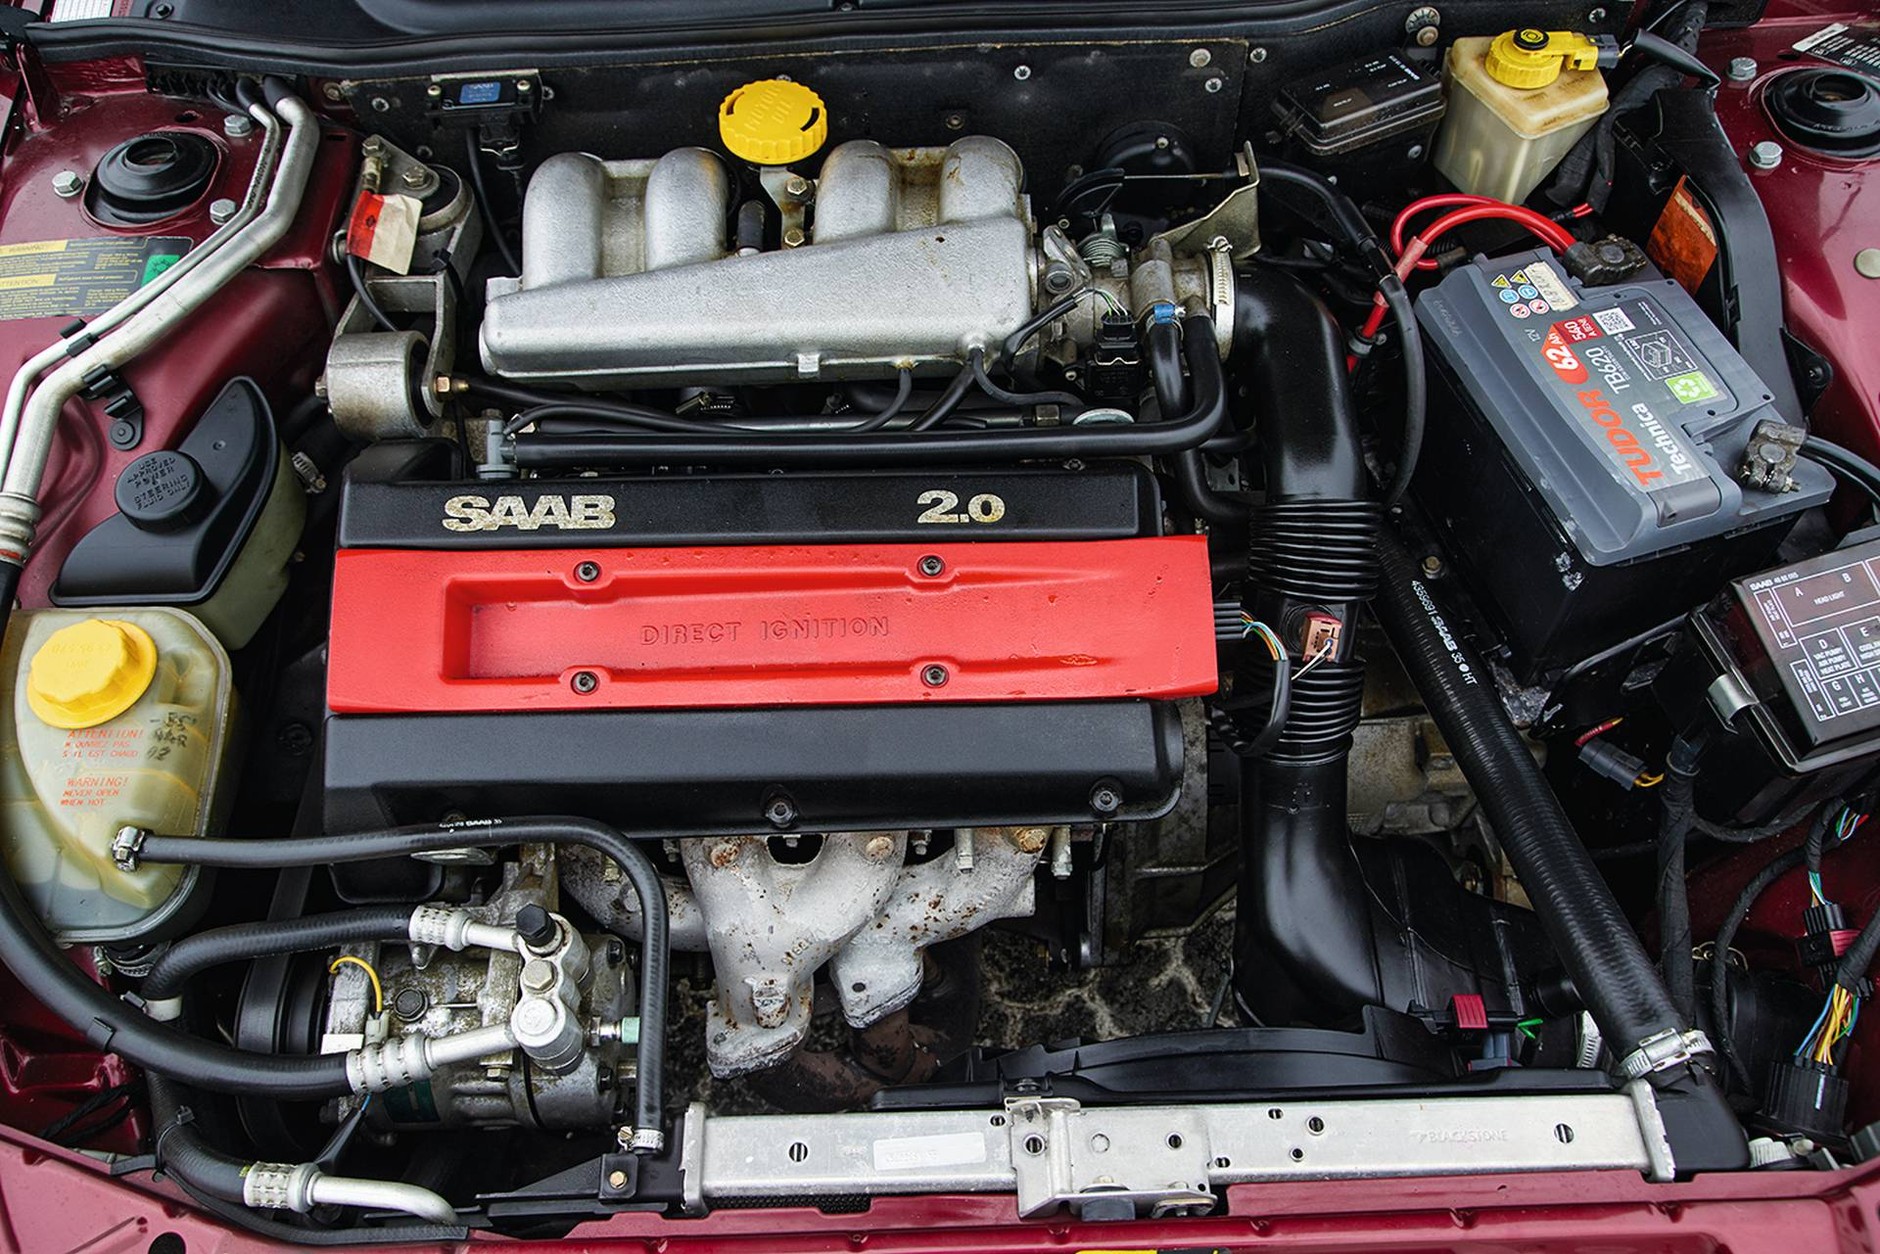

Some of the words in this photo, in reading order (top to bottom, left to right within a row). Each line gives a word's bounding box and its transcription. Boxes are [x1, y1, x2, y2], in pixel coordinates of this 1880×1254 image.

[1564, 321, 1587, 341] 540
[1549, 333, 1563, 346] Ah
[1546, 347, 1579, 371] 62
[1585, 346, 1631, 395] TB620
[1576, 388, 1664, 486] TUDOR
[1631, 403, 1693, 475] Technica
[441, 494, 617, 532] SAAB
[916, 489, 1006, 525] 2.0
[1841, 572, 1852, 583] B
[1750, 579, 1774, 591] SAAB
[1793, 586, 1804, 597] A
[640, 621, 742, 646] DIRECT
[761, 615, 890, 641] IGNITION
[1859, 626, 1870, 637] E
[1430, 615, 1458, 652] SAAB
[1451, 651, 1466, 664] 35
[1462, 672, 1479, 685] HT
[1819, 639, 1828, 650] D
[1854, 673, 1866, 684] H
[1831, 680, 1842, 691] G
[66, 776, 129, 788] WARNING!
[63, 788, 93, 797] NEVER
[95, 788, 119, 797] OPEN
[60, 798, 84, 806] WHEN
[87, 798, 105, 806] HOT
